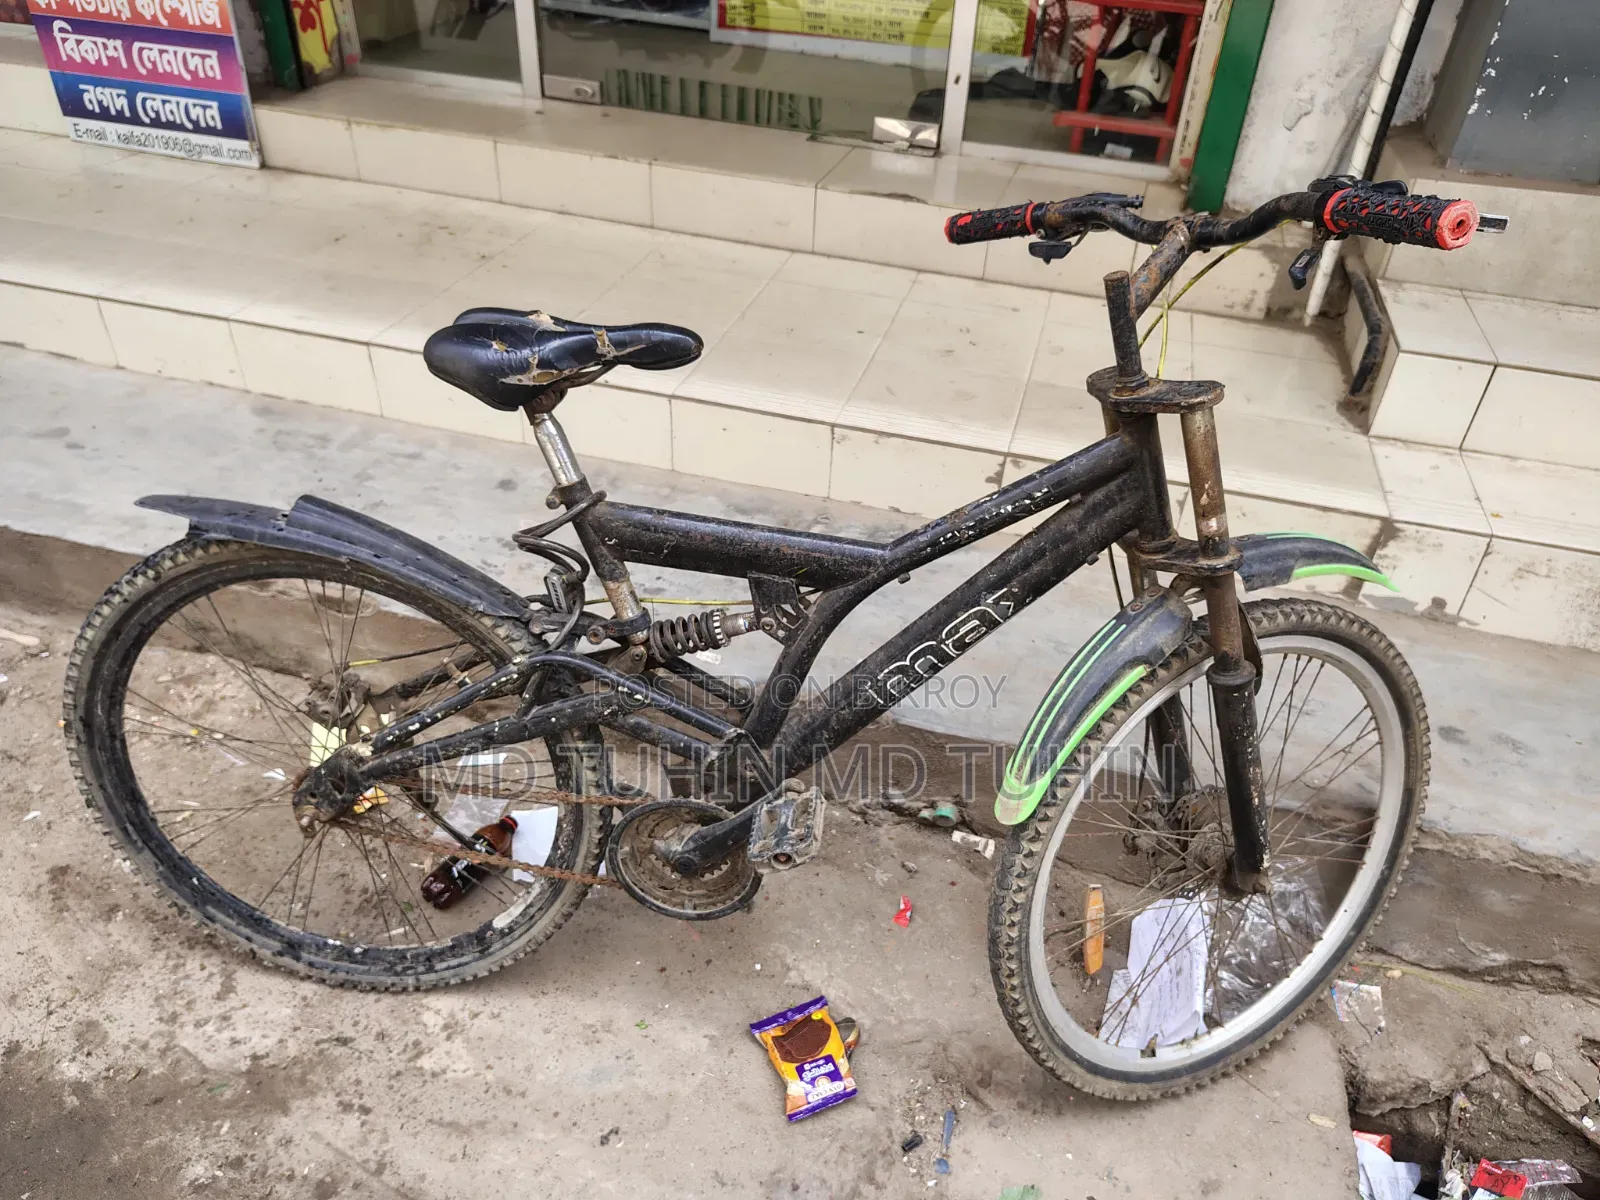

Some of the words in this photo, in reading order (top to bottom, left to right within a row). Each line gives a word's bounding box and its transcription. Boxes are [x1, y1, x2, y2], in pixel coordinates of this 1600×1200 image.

[53, 20, 127, 69] বিকাশ
[132, 41, 222, 80] লেনদেন
[79, 84, 130, 118] নগদ
[136, 92, 222, 130] লেনদেন
[73, 123, 108, 142] E-mail
